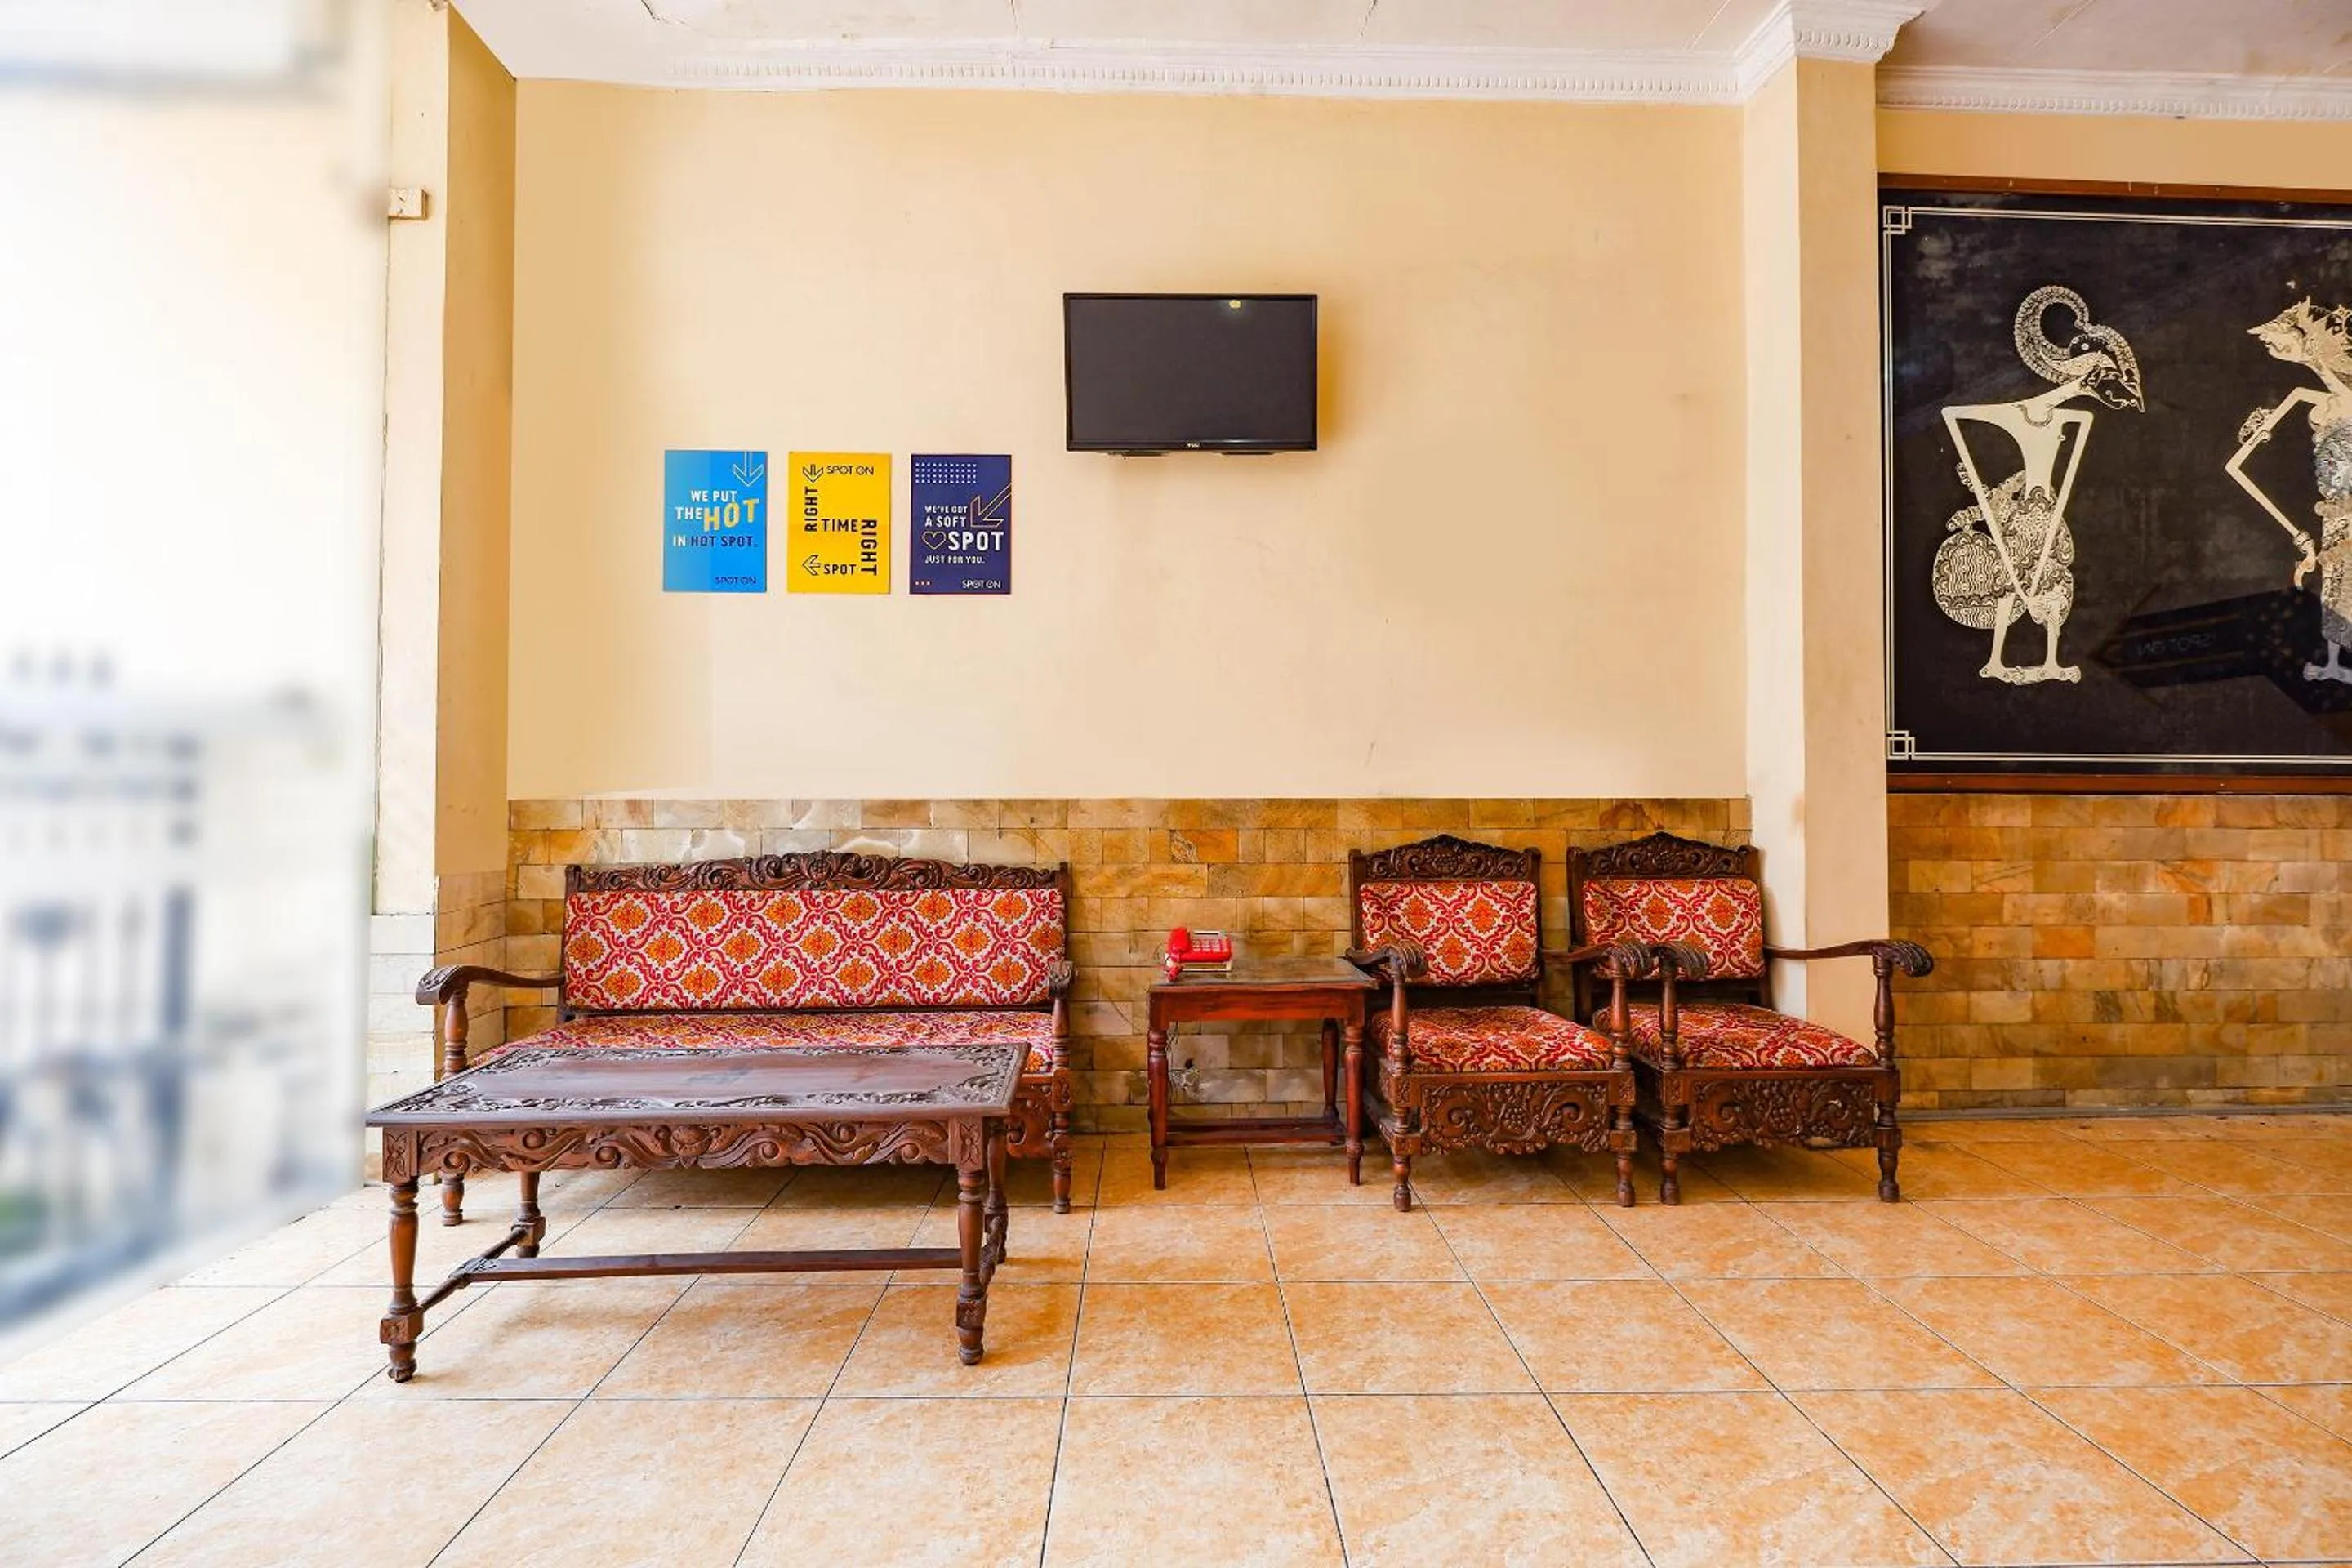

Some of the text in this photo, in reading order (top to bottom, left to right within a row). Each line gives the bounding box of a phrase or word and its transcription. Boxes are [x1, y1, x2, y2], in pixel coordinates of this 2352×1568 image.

[826, 465, 874, 475] SPOT ON
[690, 490, 737, 503] WE PUT
[675, 498, 760, 532] THE HOT
[804, 486, 817, 532] RIGHT
[951, 506, 968, 514] GOT
[822, 519, 858, 532] TIME
[924, 515, 967, 528] A SOFT
[673, 535, 686, 546] IN
[691, 536, 717, 546] HOT
[948, 532, 1004, 551] SPOT
[861, 519, 877, 576] RIGHT
[924, 555, 945, 564] JUST
[947, 555, 964, 564] FOR
[824, 564, 857, 575] SPOT
[715, 576, 757, 585] SPOT ON
[962, 580, 1001, 589] SPOT ON
